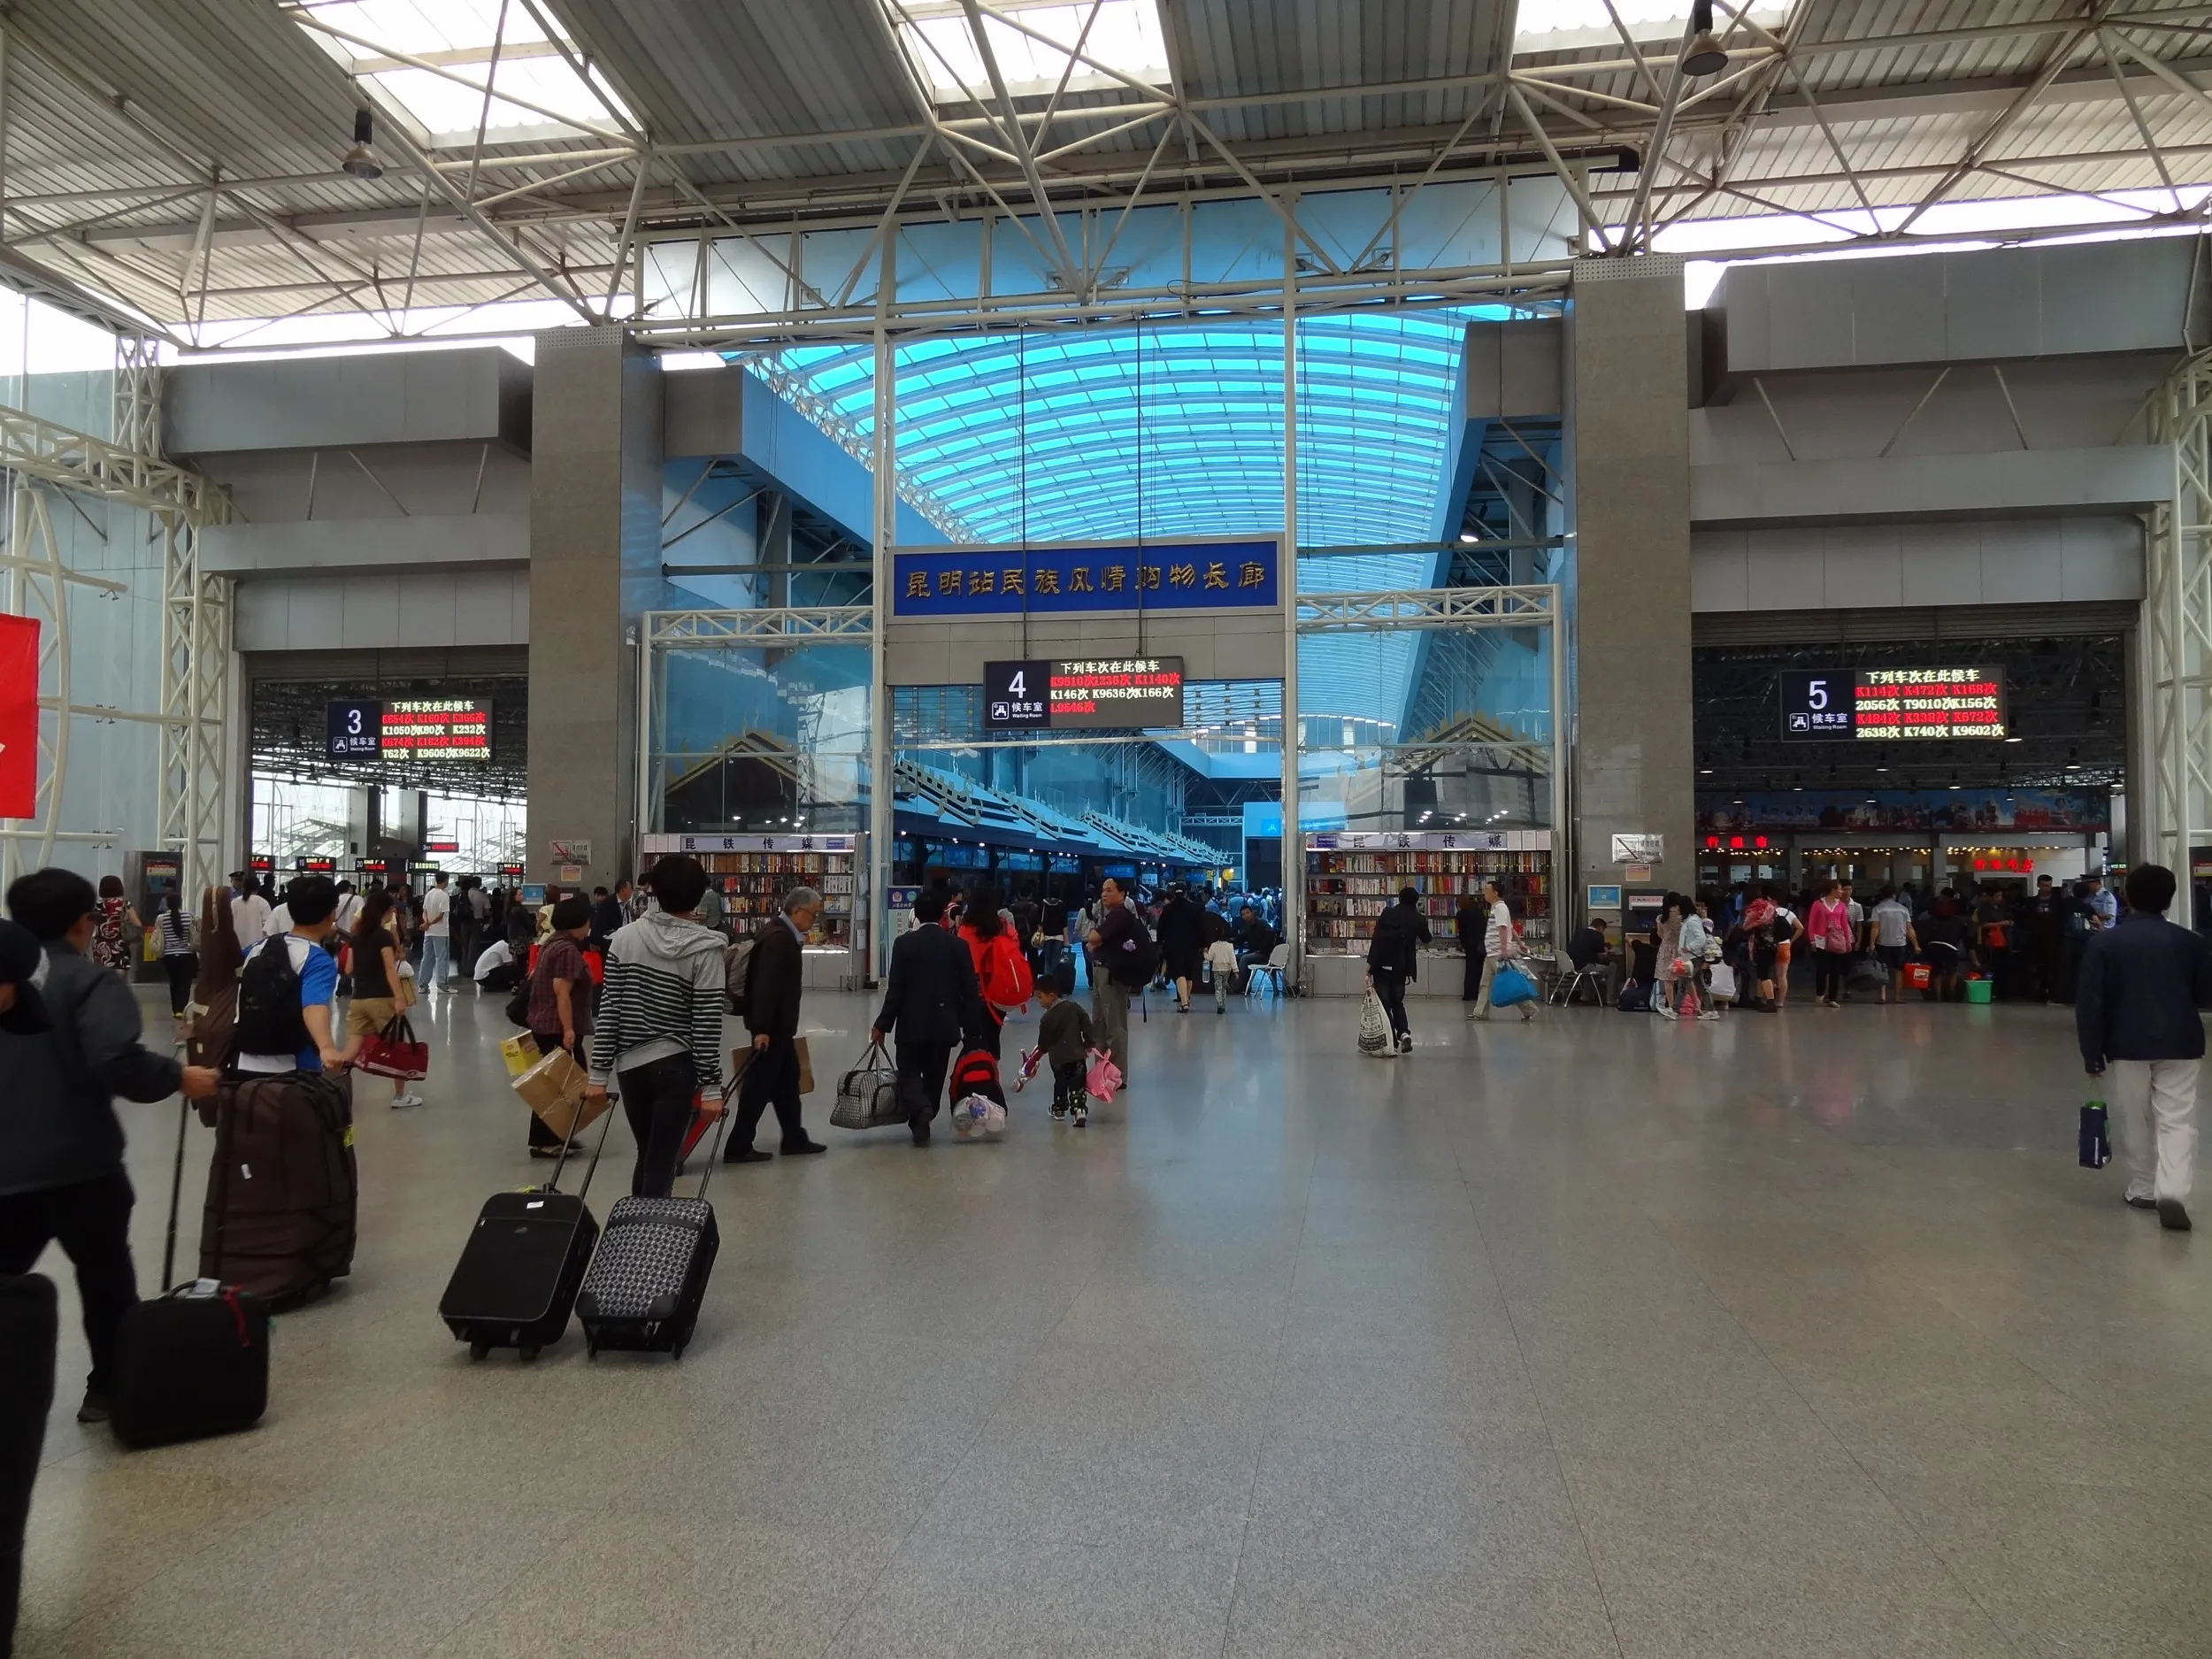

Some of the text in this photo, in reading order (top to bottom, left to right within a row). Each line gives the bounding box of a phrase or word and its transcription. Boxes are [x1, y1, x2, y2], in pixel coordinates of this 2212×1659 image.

[905, 560, 1265, 599] 昆明站民族风情购物长廊
[1061, 660, 1160, 674] 下列车次在此候车
[1866, 669, 1979, 684] 下列车次在此候车
[1009, 671, 1026, 699] 4
[1050, 686, 1174, 700] K146次 K9636次 K166次
[1809, 680, 1828, 710] 5
[391, 701, 474, 713] 下列车次在此候车
[1011, 702, 1043, 712] 候车室
[1855, 696, 1997, 710] 2056次 T9010次 K156次
[348, 709, 362, 734] 3
[1812, 712, 1847, 724] 候车室
[452, 724, 486, 735] K232次
[1856, 724, 2005, 739] 2638次 K740次 K9602次
[349, 737, 376, 747] 候车室
[383, 747, 490, 759] T62次 K9606次 K9622次
[685, 836, 815, 850] 昆铁传媒
[1353, 834, 1502, 849] 昆铁传媒
